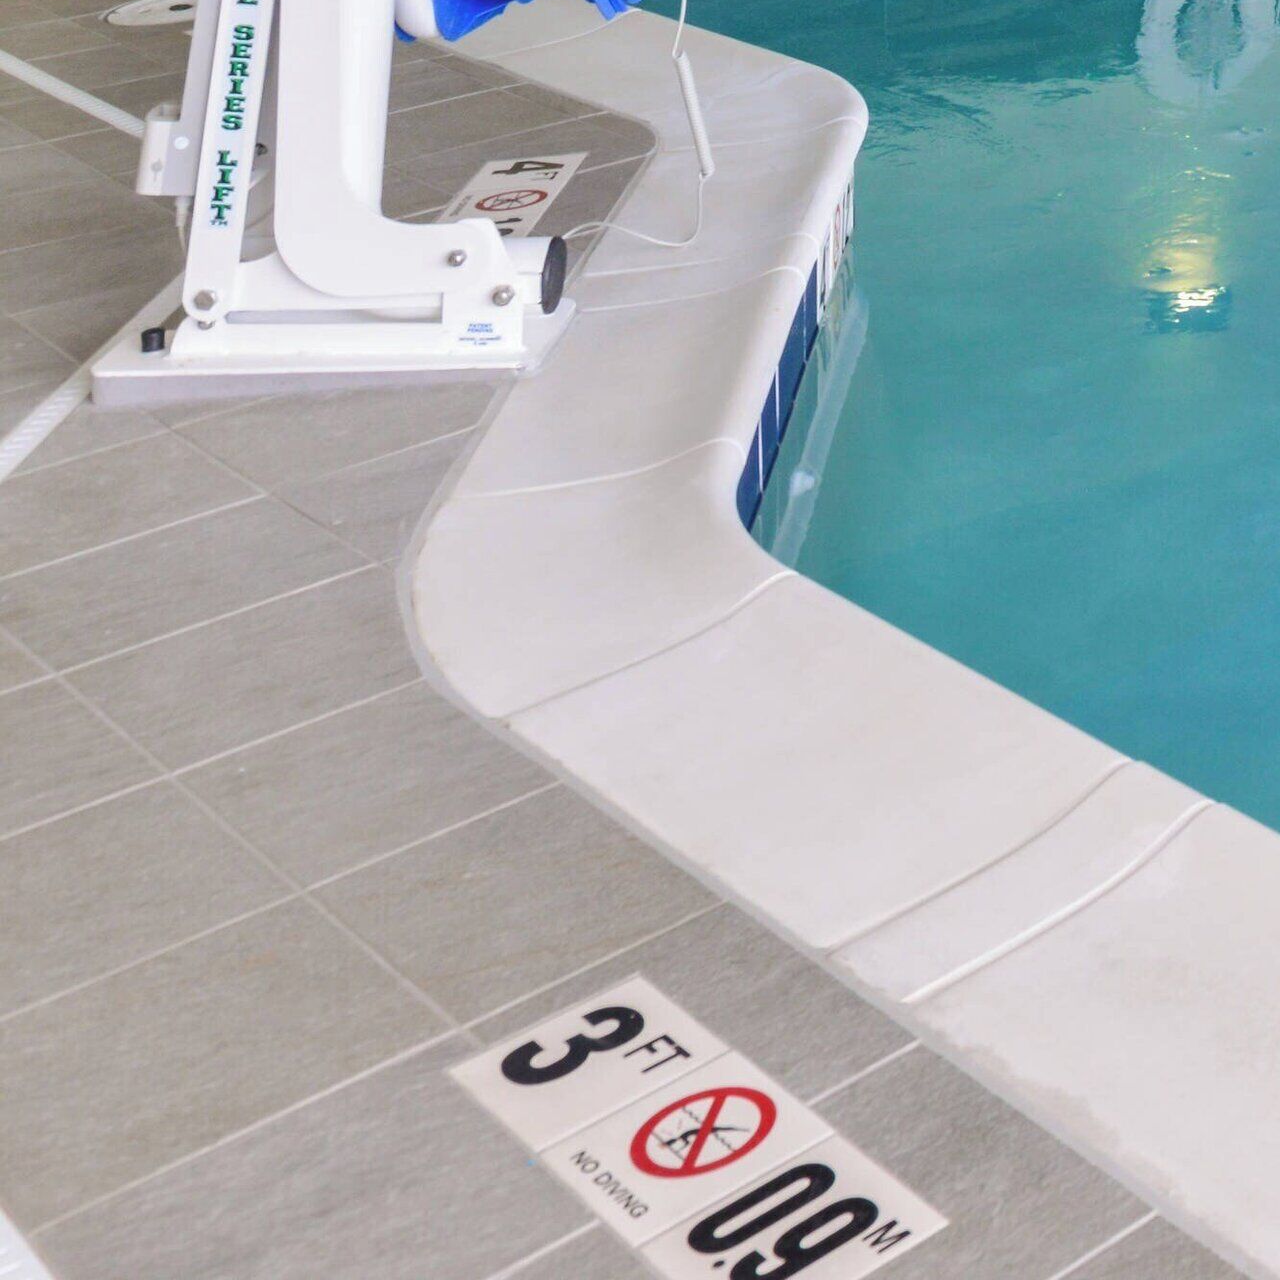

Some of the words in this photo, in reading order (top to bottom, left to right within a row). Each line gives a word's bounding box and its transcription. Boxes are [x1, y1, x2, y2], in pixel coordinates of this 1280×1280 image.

[220, 24, 255, 131] SERIES
[491, 160, 565, 175] 4
[501, 1005, 645, 1086] 3
[623, 1033, 692, 1074] FT
[569, 1150, 600, 1174] NO
[593, 1171, 649, 1219] DIVING
[862, 1219, 913, 1256] M
